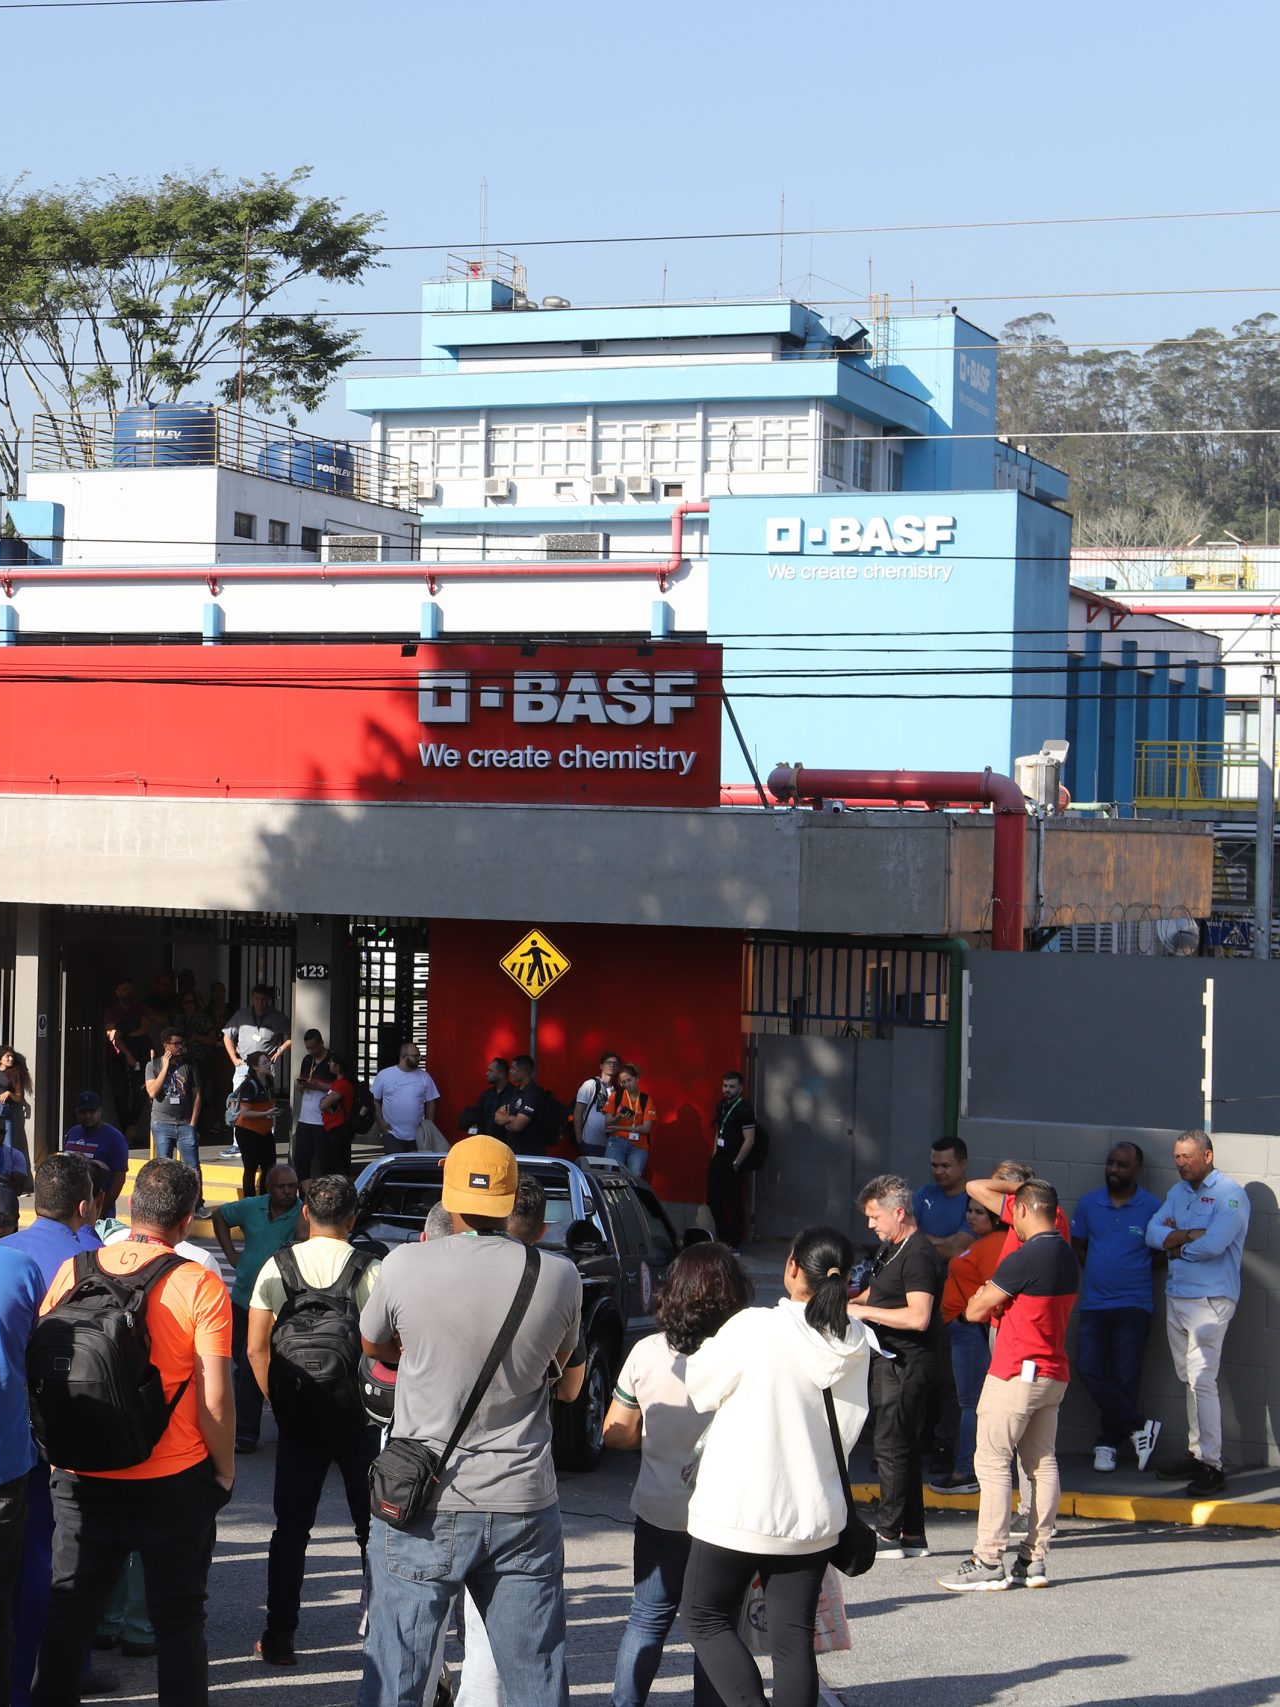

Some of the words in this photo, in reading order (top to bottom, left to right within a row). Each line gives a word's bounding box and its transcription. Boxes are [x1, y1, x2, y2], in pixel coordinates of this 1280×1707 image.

[829, 514, 956, 555] BASF
[767, 563, 797, 580] We
[800, 563, 859, 580] create
[863, 563, 954, 583] chemistry
[513, 669, 697, 725] BASF
[418, 742, 461, 768] We
[467, 744, 552, 769] create
[558, 743, 697, 775] chemistry
[301, 965, 325, 978] 123
